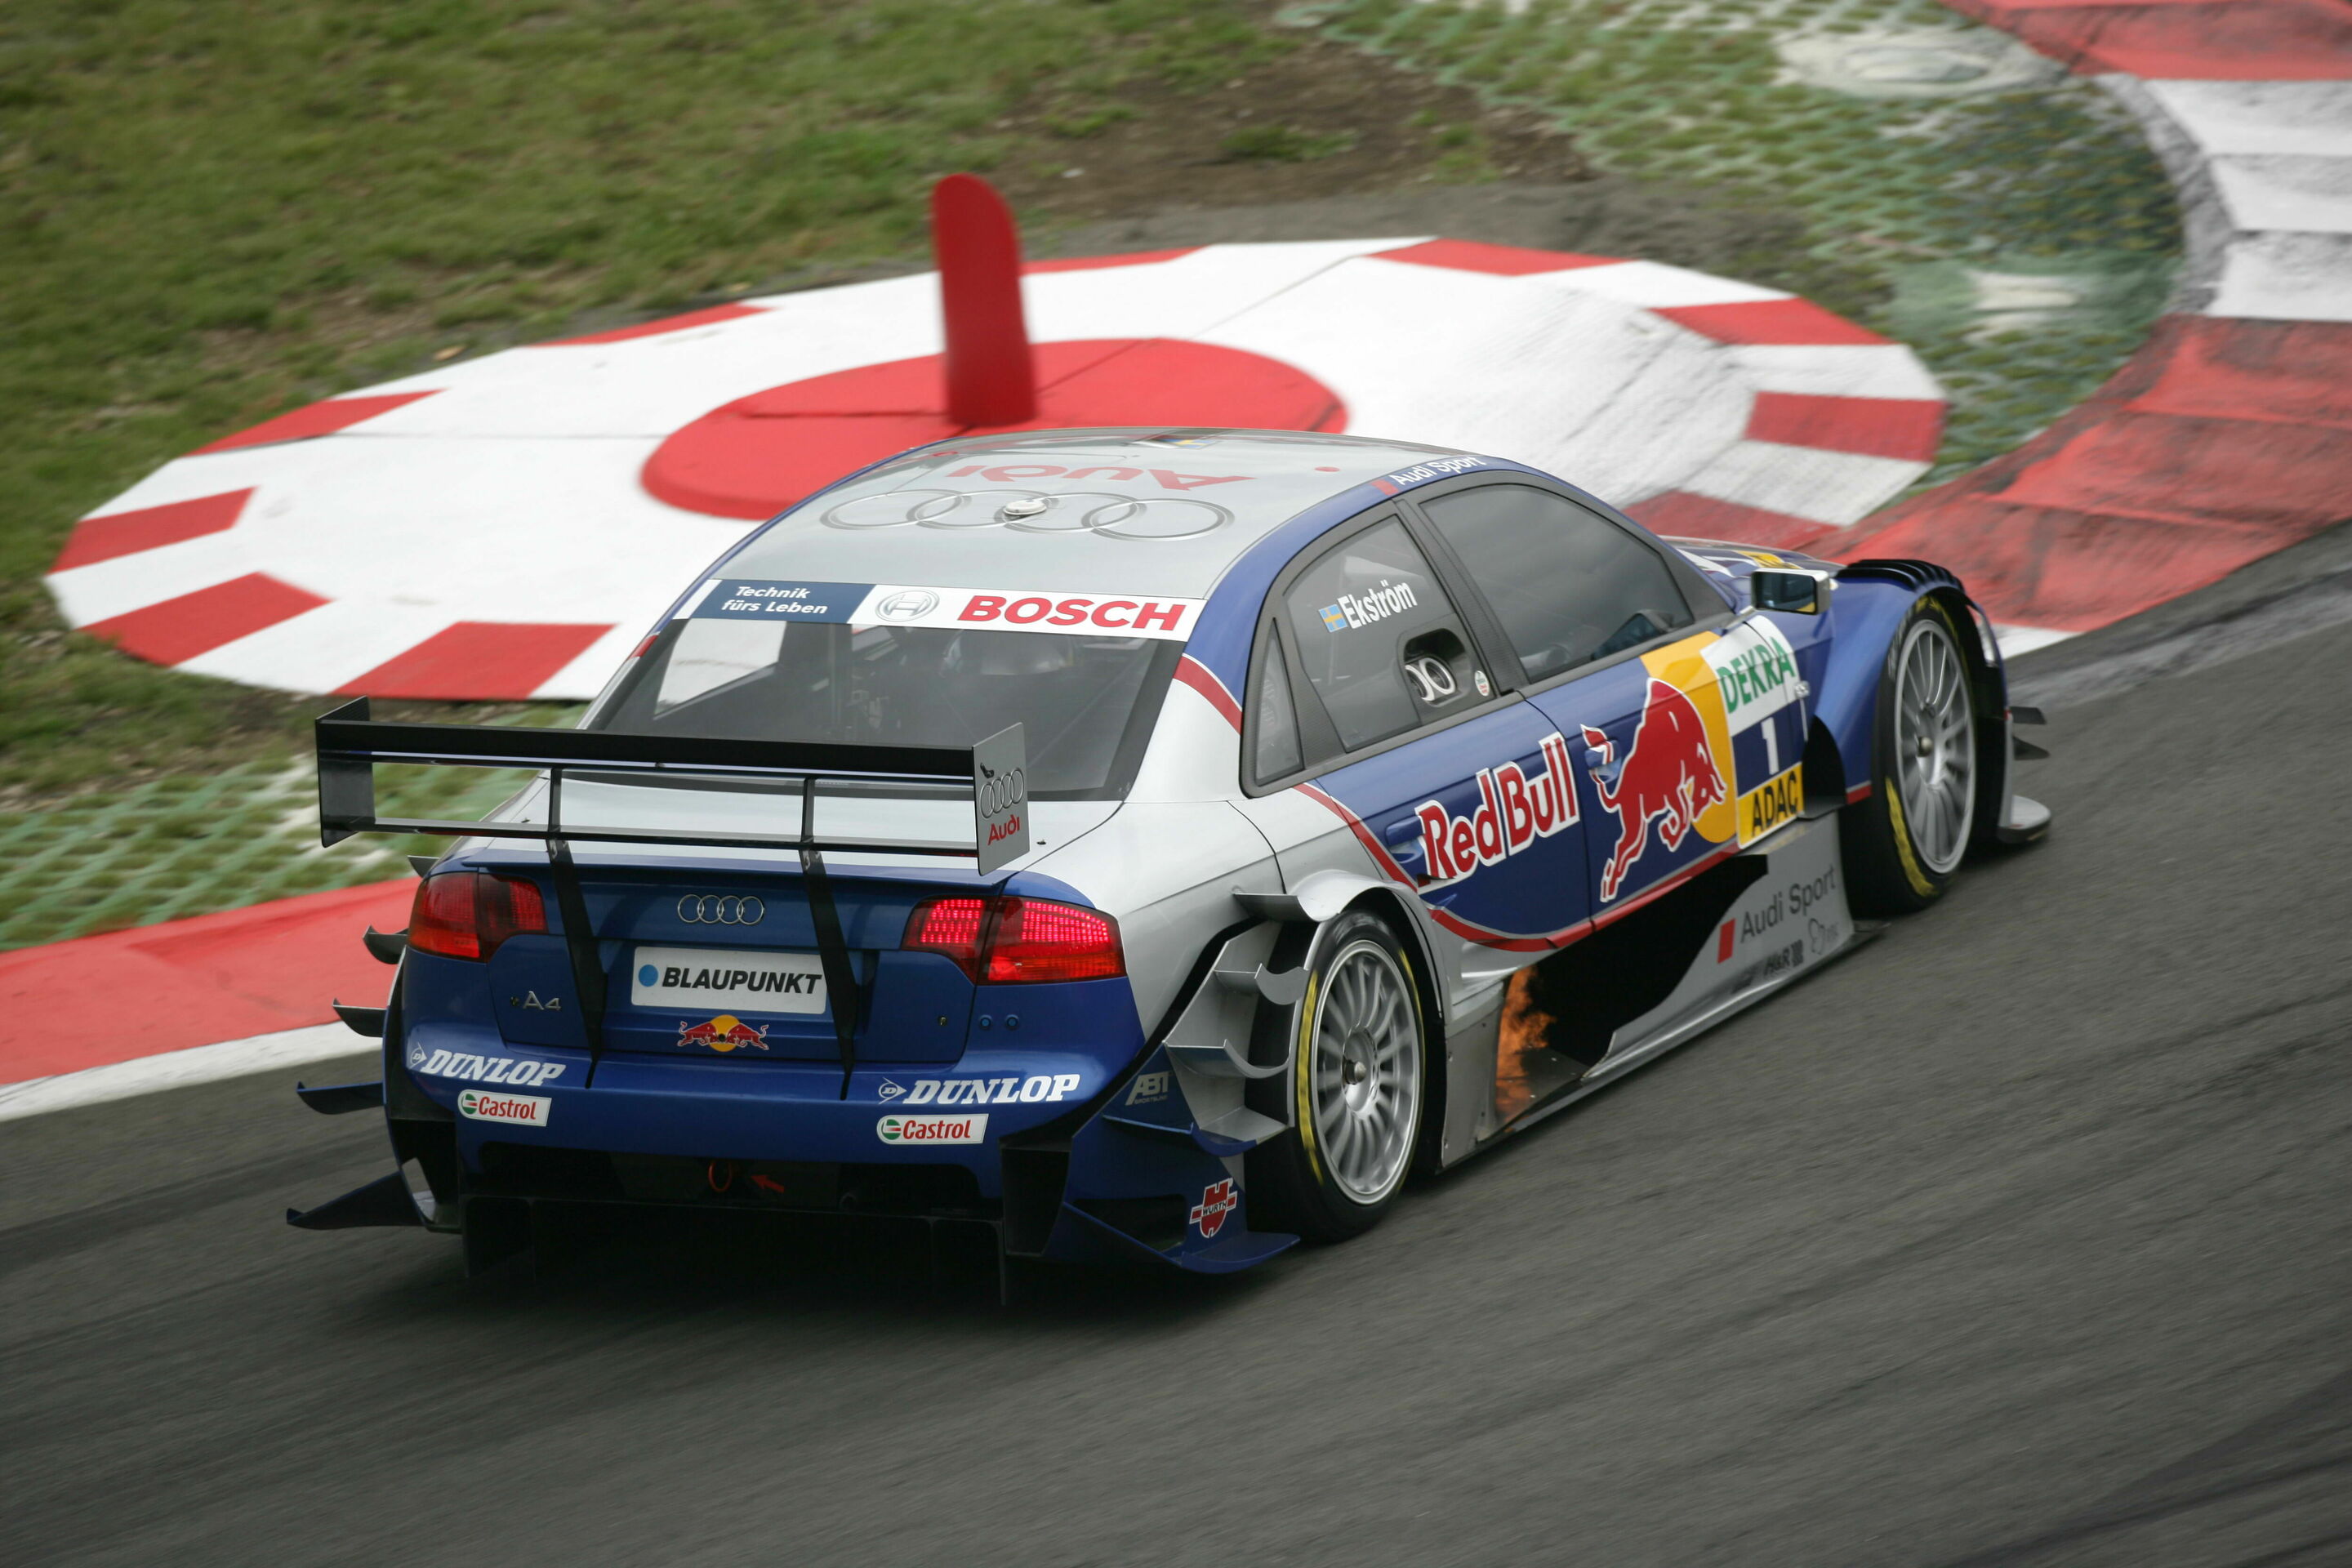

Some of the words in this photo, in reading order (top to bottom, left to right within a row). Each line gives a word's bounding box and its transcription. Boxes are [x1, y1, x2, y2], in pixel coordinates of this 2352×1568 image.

[945, 465, 1256, 491] Audi
[1389, 466, 1437, 485] Audi
[1428, 457, 1486, 474] Sport
[721, 599, 761, 611] fürs
[765, 601, 828, 614] Leben
[736, 586, 810, 599] Technik
[1337, 579, 1418, 629] Ekström
[957, 595, 1187, 630] BOSCH
[1716, 636, 1796, 715] DEKRA
[1761, 716, 1780, 775] 1
[1416, 770, 1504, 880] Red
[1494, 734, 1579, 851] Bull
[1752, 770, 1798, 840] ADAC
[987, 814, 1020, 846] Audi
[1740, 891, 1784, 944] Audi
[1788, 864, 1837, 916] Sport
[662, 967, 822, 995] BLAUPUNKT
[523, 990, 562, 1011] A4
[420, 1049, 567, 1087] DUNLOP
[902, 1074, 1080, 1104] DUNLOP
[1125, 1071, 1170, 1106] ABT
[479, 1096, 537, 1120] Castrol
[902, 1119, 972, 1140] Castrol
